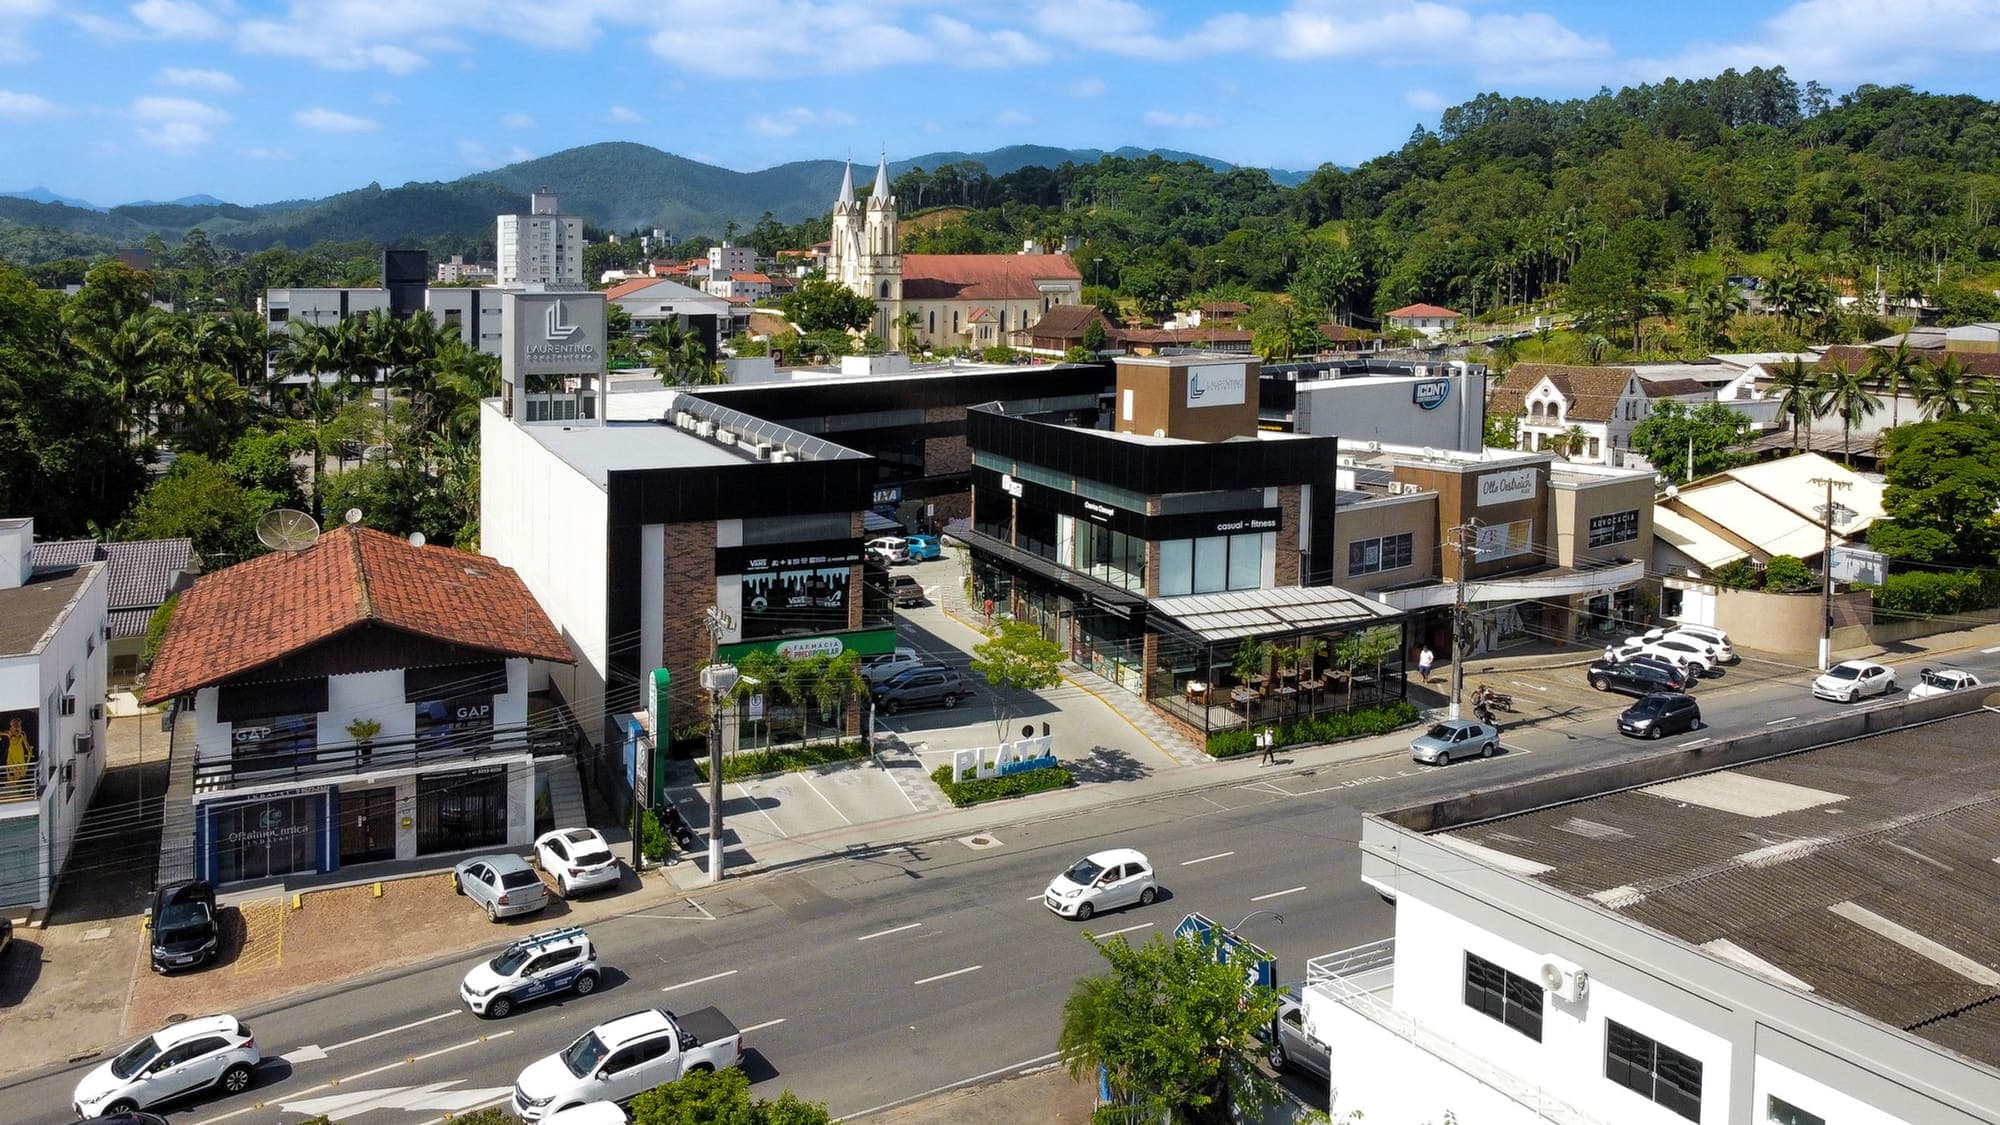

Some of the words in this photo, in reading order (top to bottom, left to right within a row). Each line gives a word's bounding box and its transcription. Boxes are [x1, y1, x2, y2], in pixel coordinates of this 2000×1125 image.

[526, 343, 593, 353] LAURENTINO
[1417, 382, 1446, 397] ICONT
[873, 489, 897, 502] IXA
[1217, 520, 1243, 531] casual
[1251, 519, 1276, 528] fitness
[1593, 514, 1635, 529] ADVOCACIA
[457, 705, 489, 718] GAP
[236, 727, 271, 741] GAP
[953, 735, 1052, 783] PLATZ
